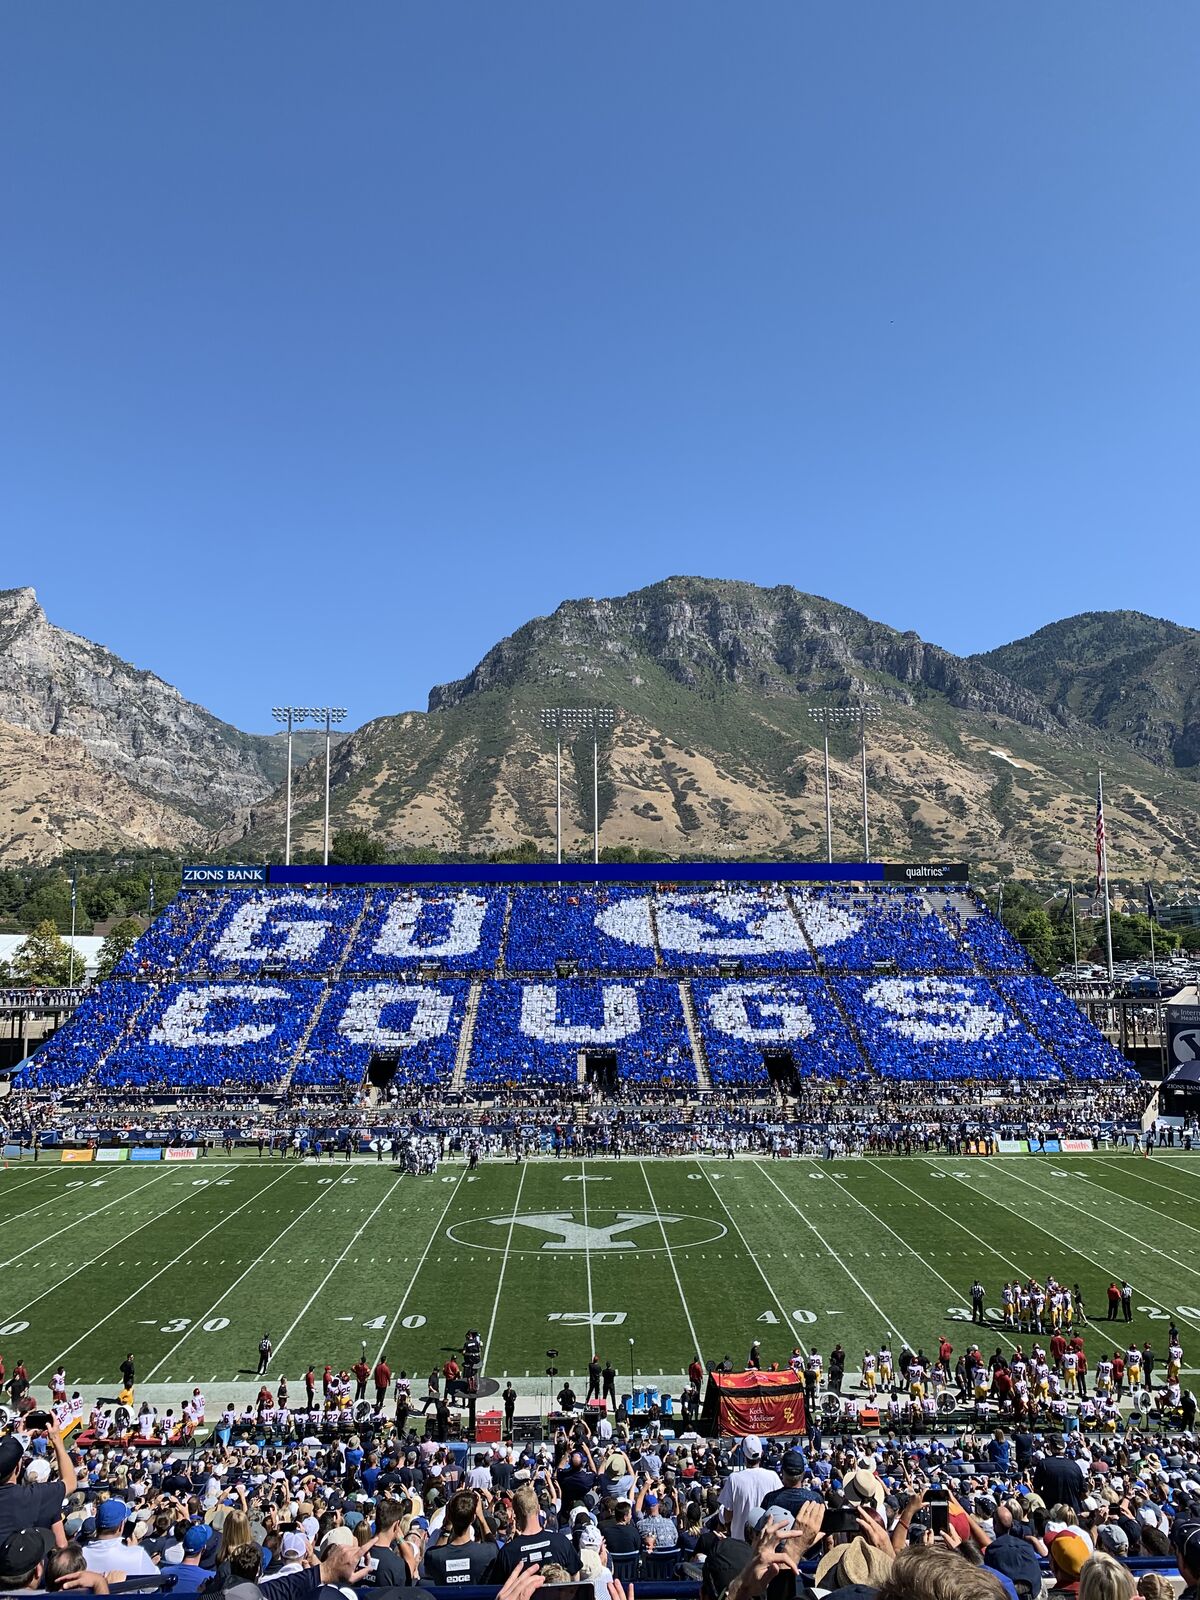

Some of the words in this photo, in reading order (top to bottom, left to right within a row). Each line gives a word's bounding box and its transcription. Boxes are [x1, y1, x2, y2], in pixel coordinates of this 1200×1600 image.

[183, 869, 224, 880] ZIONS
[226, 869, 263, 880] BANK
[905, 865, 943, 879] qualtrics
[149, 978, 1004, 1047] COUGS
[488, 1212, 685, 1249] Y
[362, 1315, 427, 1329] 40
[756, 1309, 818, 1324] 40
[160, 1318, 231, 1333] 30
[749, 1407, 763, 1415] Keck
